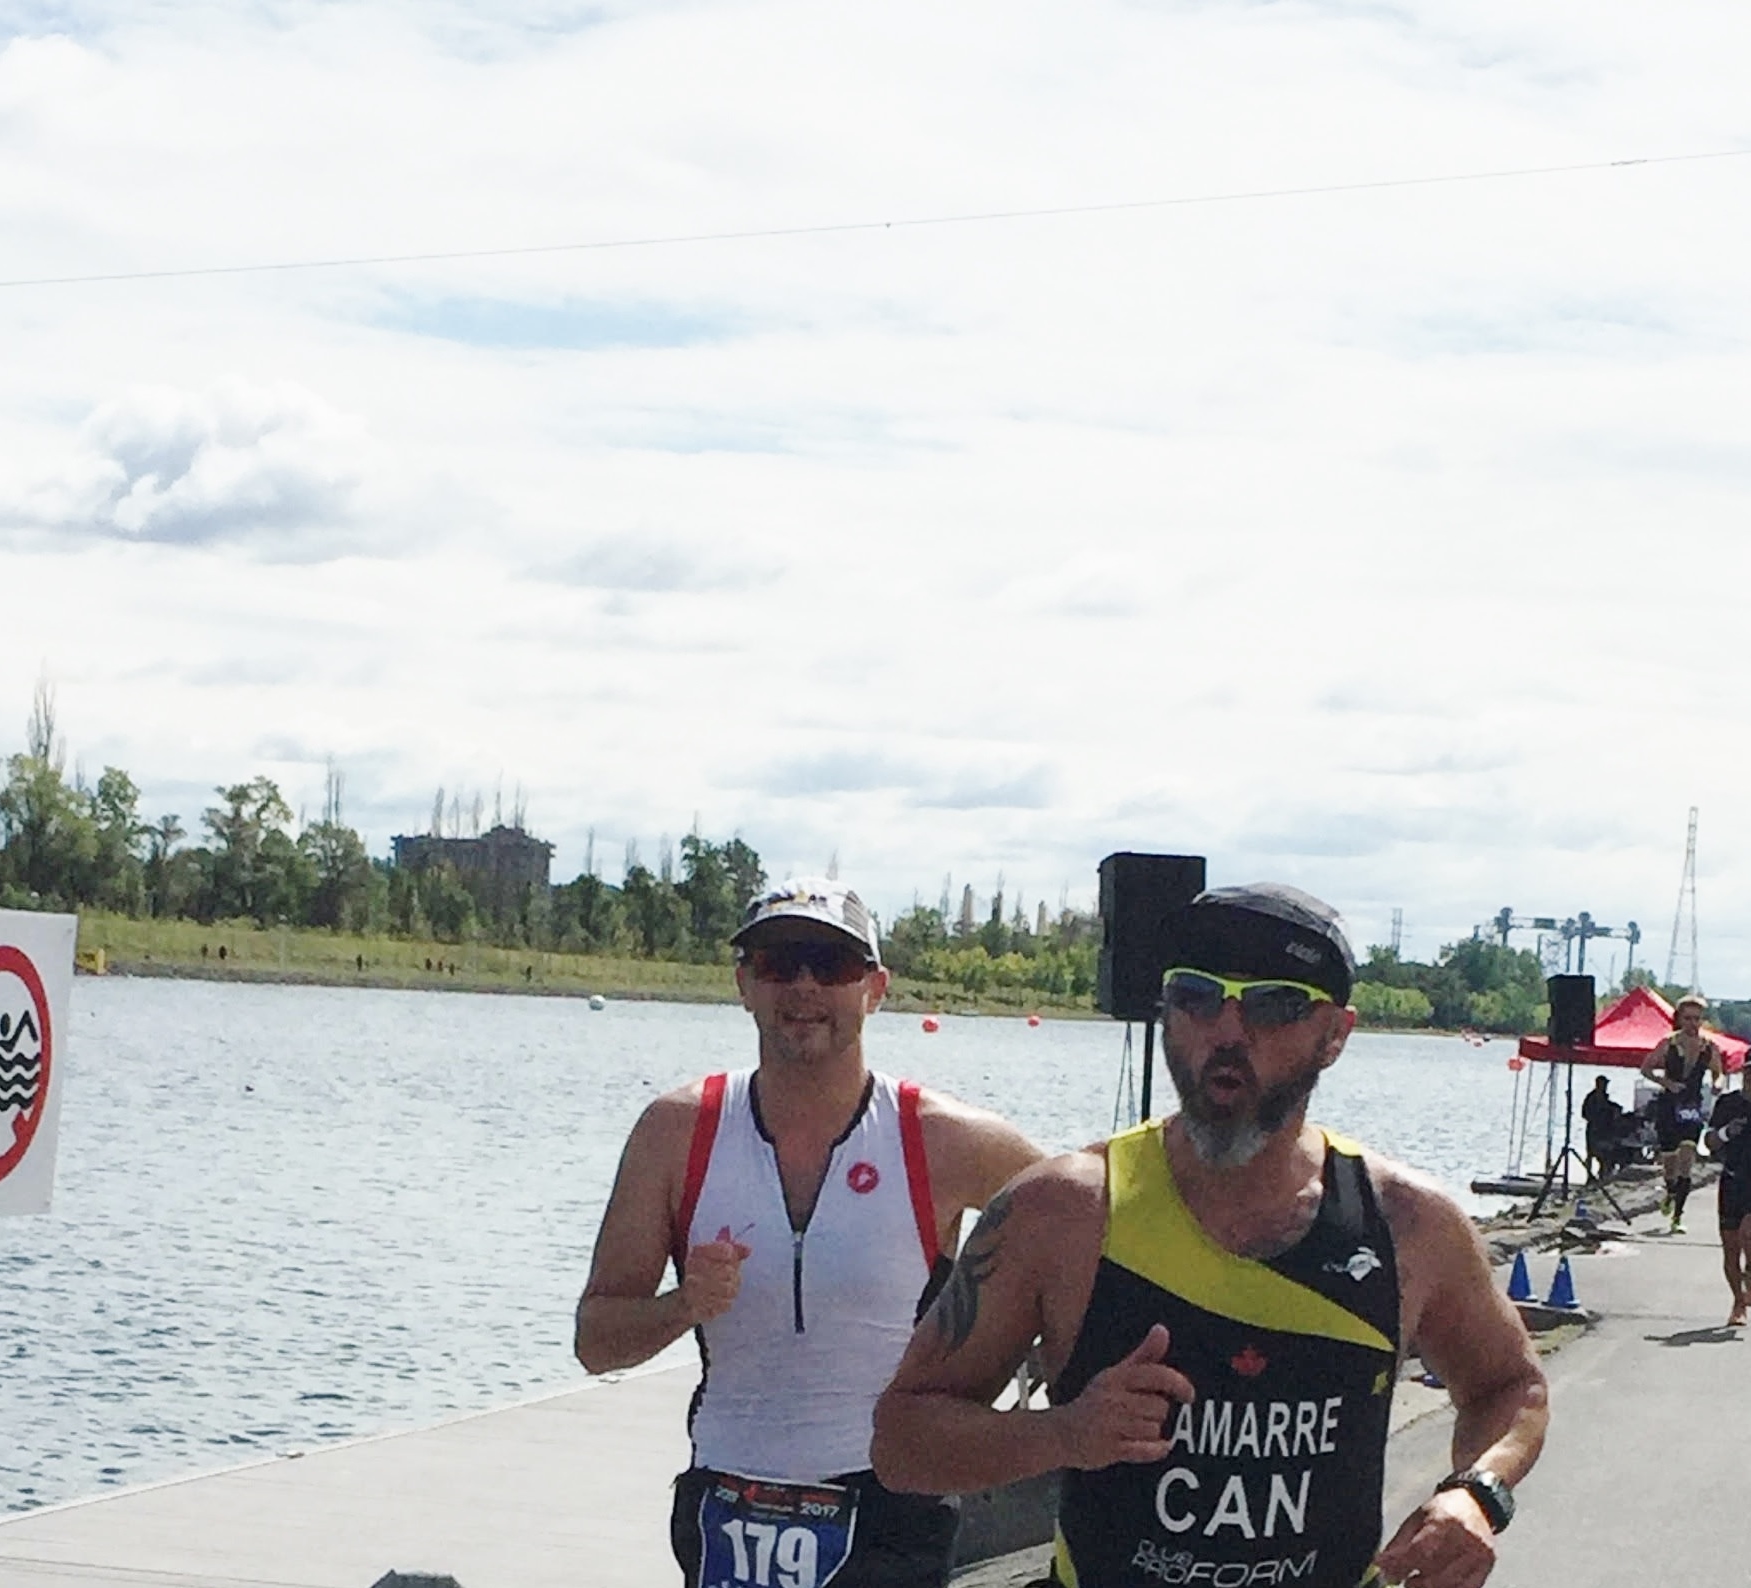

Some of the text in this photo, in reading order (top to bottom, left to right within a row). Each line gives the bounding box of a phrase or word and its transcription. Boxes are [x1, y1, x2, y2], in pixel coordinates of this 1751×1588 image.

[1169, 1396, 1342, 1459] AMARRE
[800, 1502, 841, 1518] 2017
[1155, 1467, 1312, 1539] CAN
